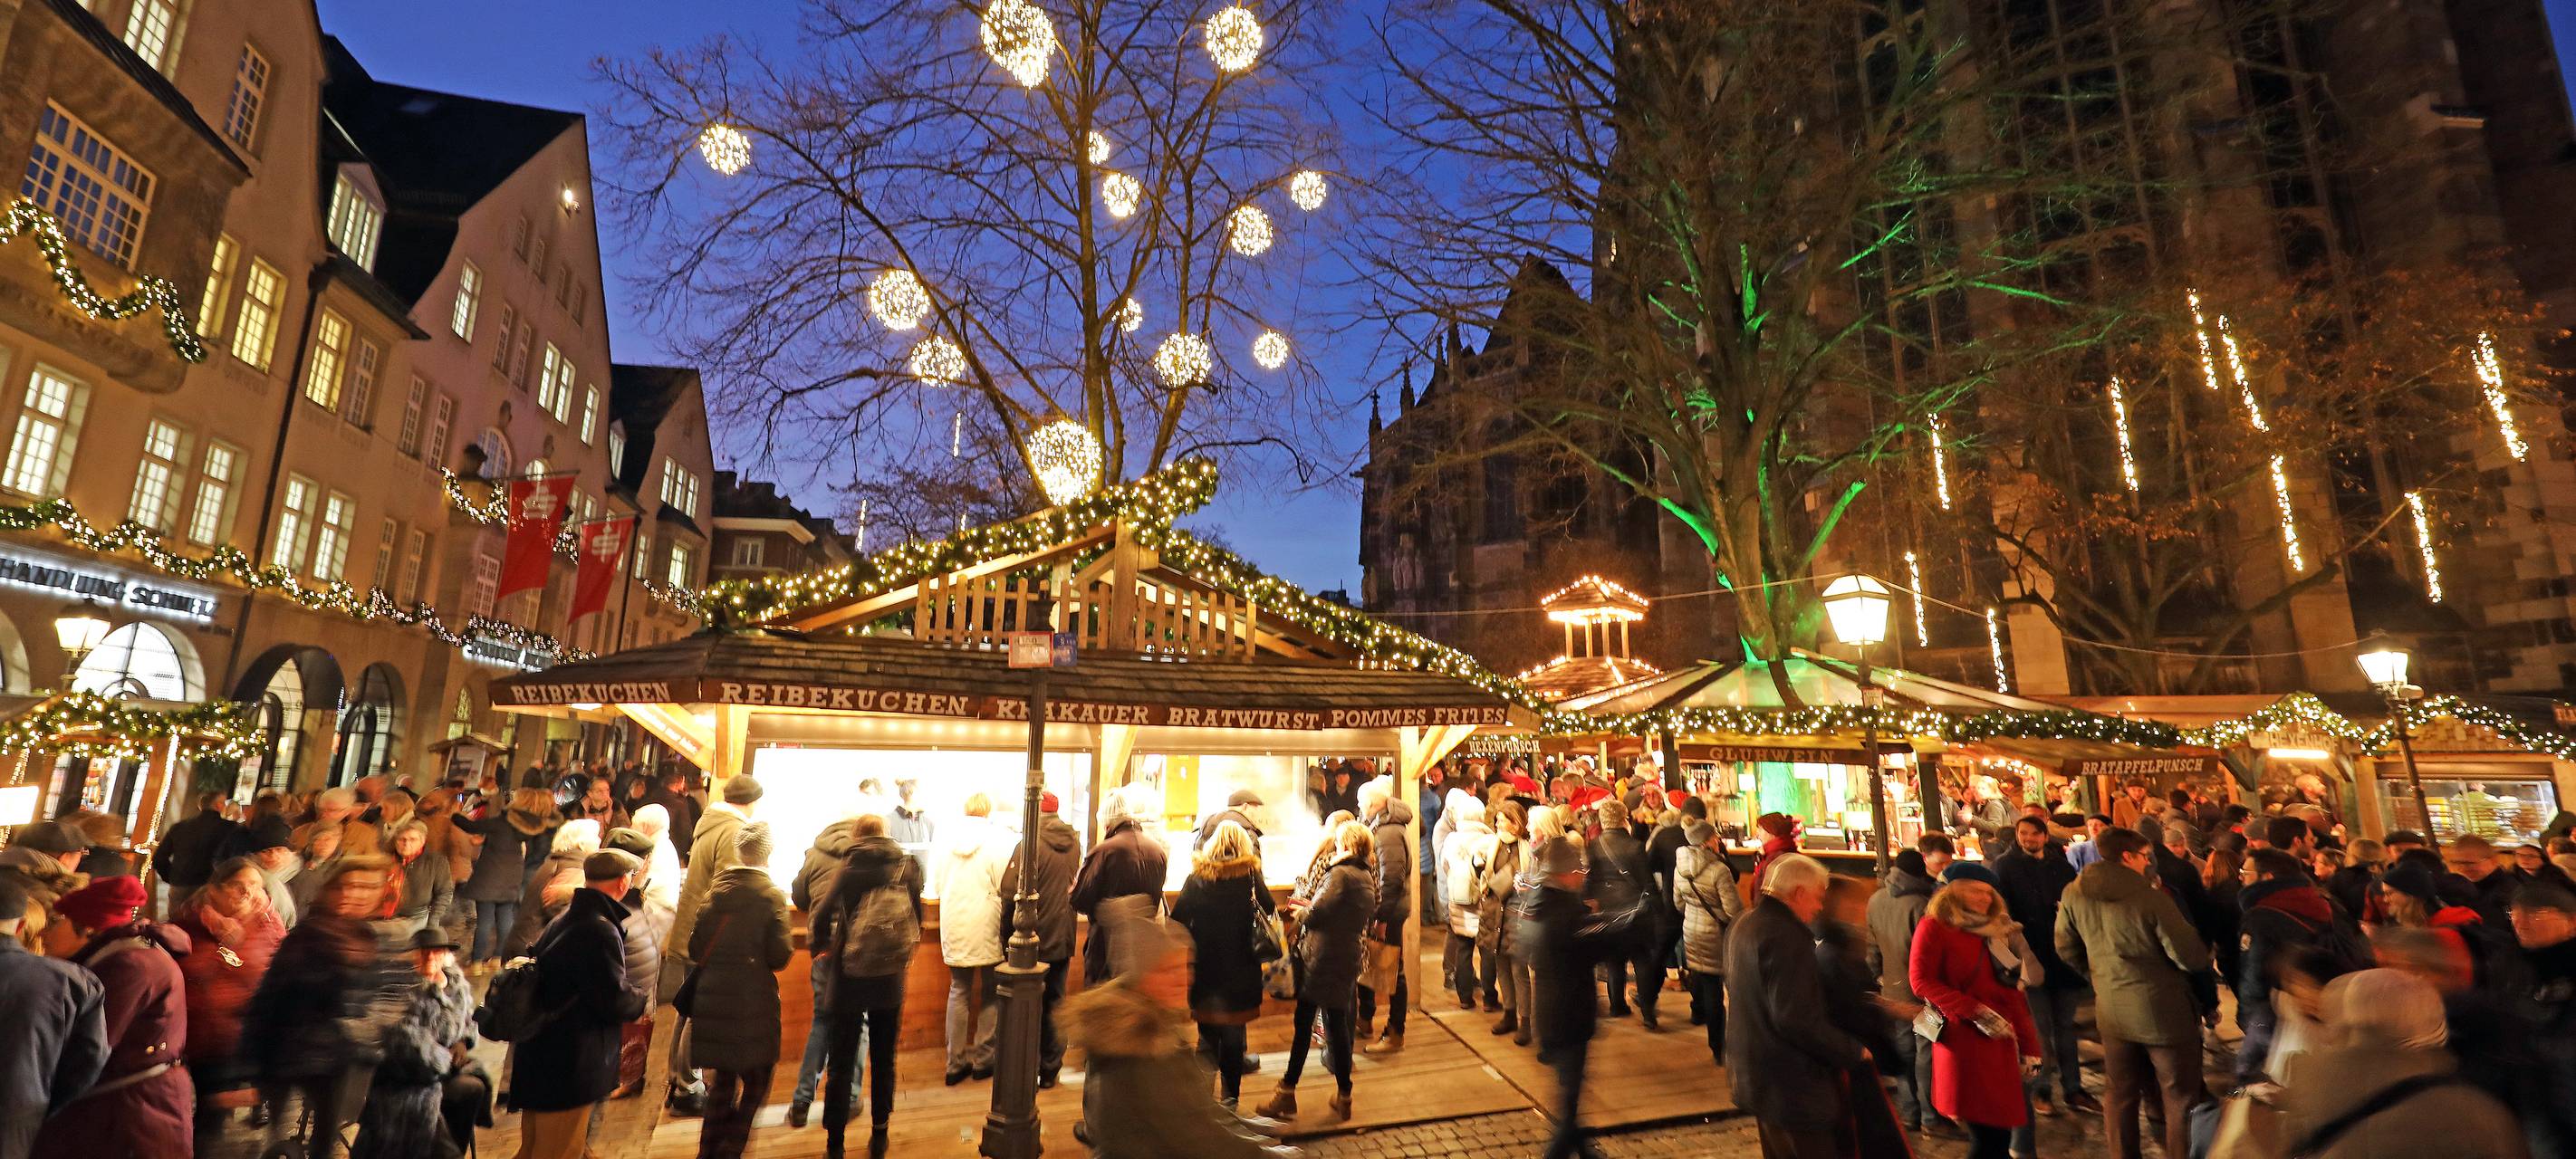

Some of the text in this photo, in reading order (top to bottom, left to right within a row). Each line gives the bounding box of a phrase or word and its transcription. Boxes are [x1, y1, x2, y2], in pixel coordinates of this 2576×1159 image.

[511, 683, 671, 704] REIBEKUCHEN
[720, 682, 969, 716] REIBEKUCHEN
[1167, 706, 1319, 730] BRATWURST
[1331, 707, 1505, 728] POMMES FRITES
[1469, 739, 1542, 754] HEXENPUNSCH
[2081, 759, 2205, 775] BRATAPFELPUNSCH
